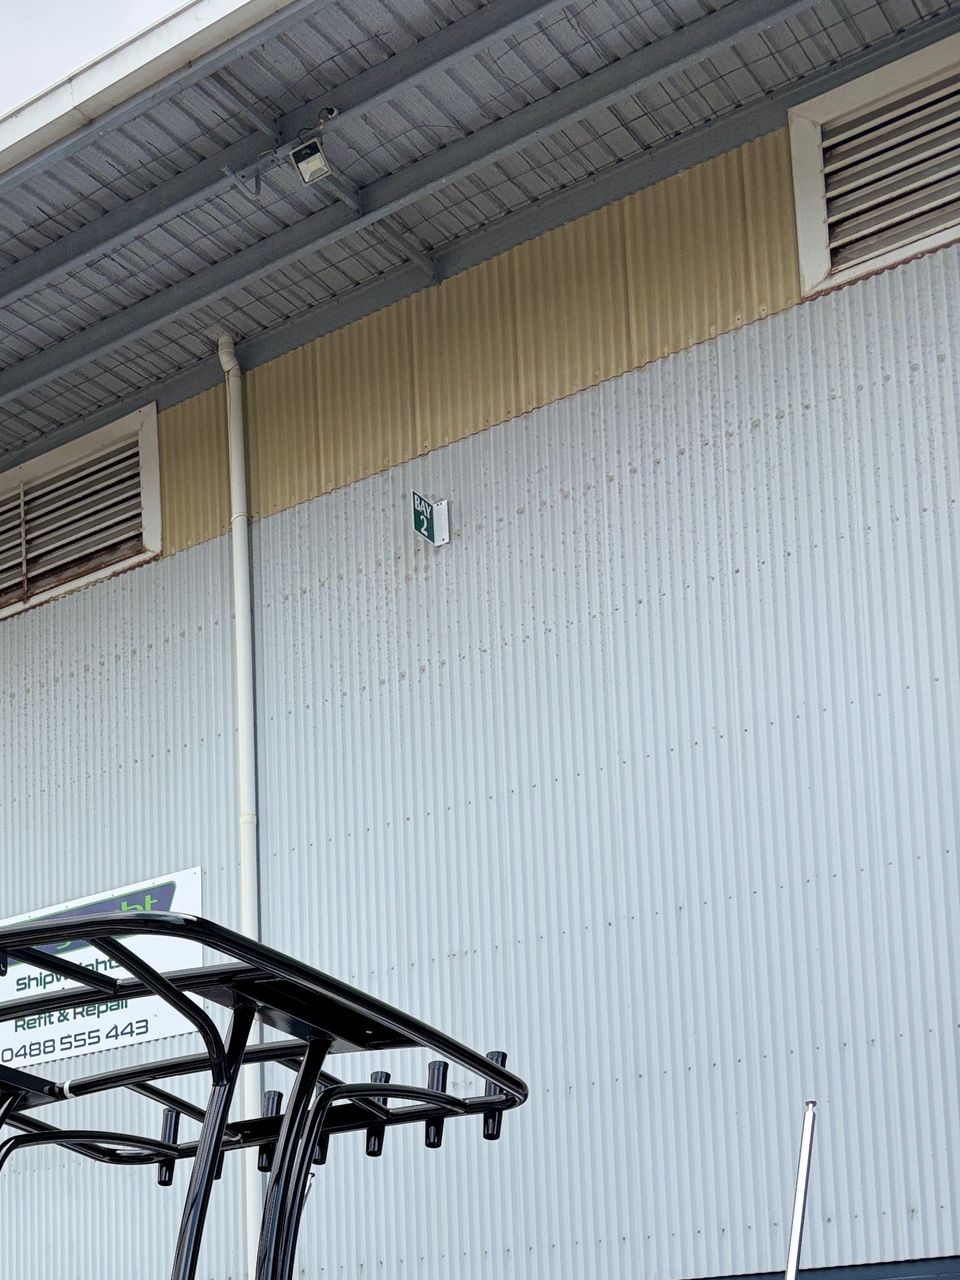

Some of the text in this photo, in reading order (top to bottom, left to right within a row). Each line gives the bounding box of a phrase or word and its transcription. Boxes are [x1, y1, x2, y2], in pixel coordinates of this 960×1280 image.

[414, 494, 432, 519] BAY
[420, 515, 428, 537] 2
[14, 1012, 54, 1033] Refit
[58, 1008, 70, 1023] &
[1, 1019, 149, 1063] 0488 555 443
